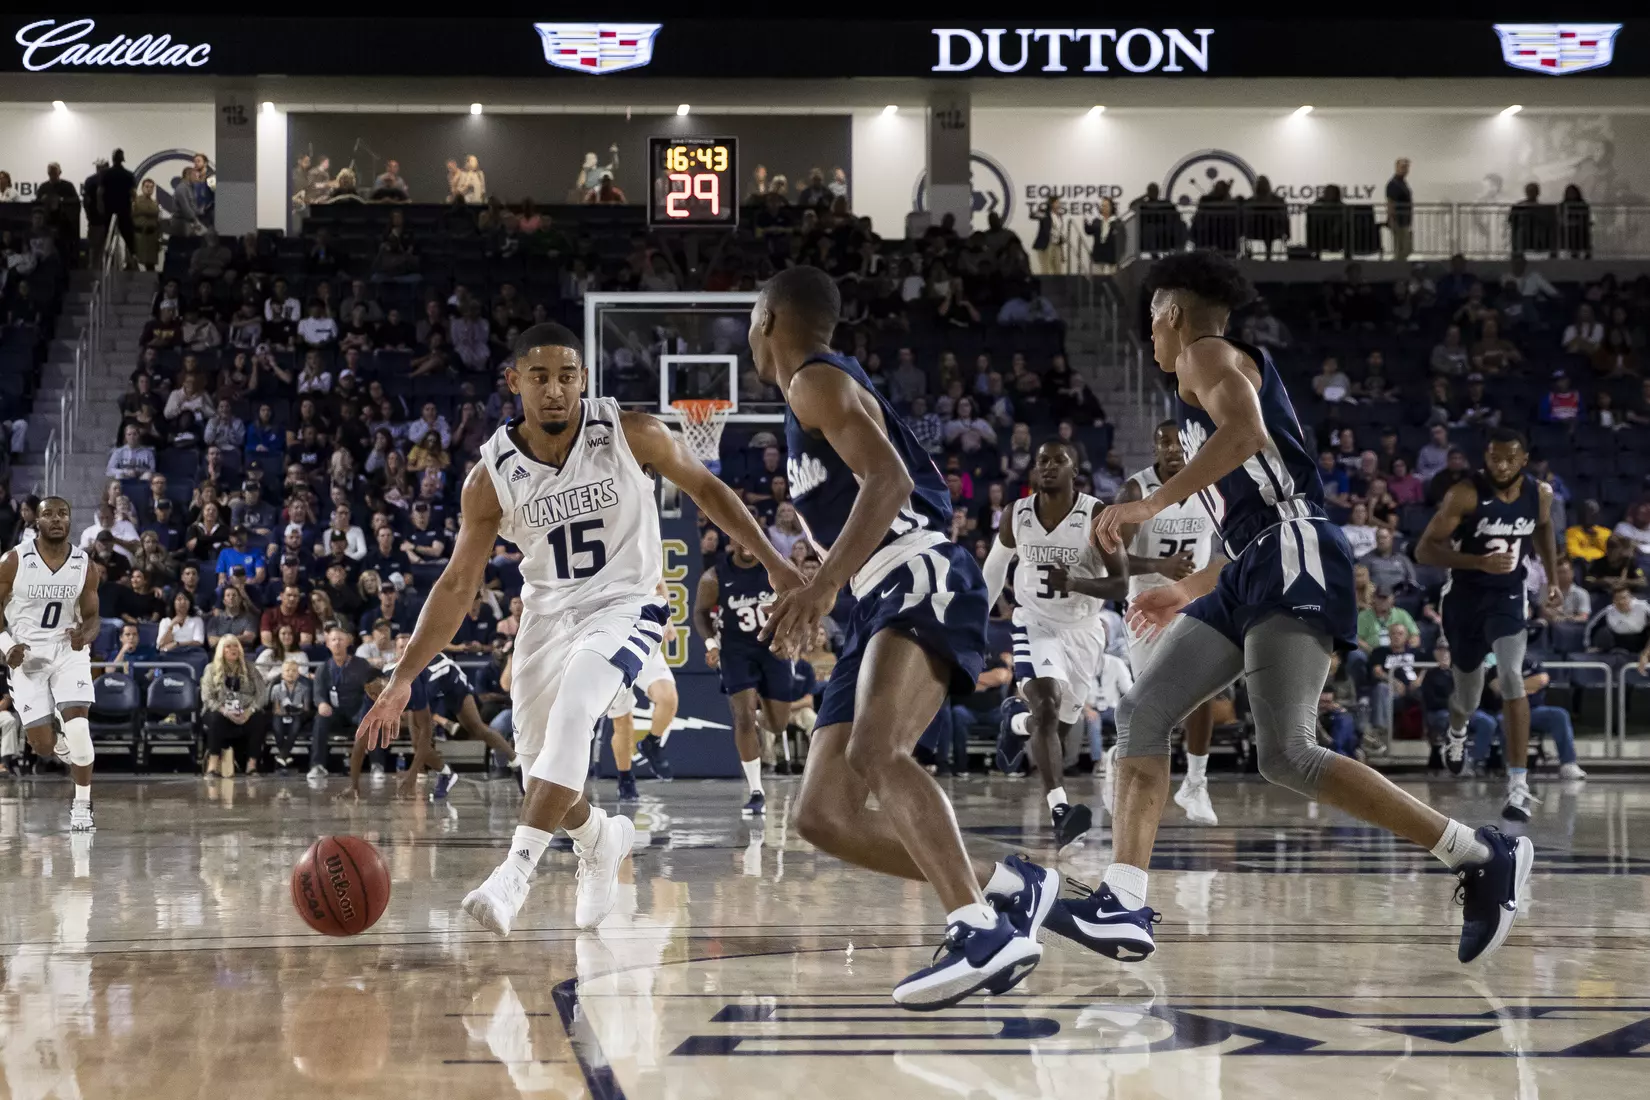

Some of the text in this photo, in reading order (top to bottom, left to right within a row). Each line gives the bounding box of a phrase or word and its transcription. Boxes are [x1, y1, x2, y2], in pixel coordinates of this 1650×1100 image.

[15, 18, 212, 71] Cadillac
[931, 28, 1215, 72] DUTTON
[666, 146, 728, 171] 16:43
[666, 173, 719, 217] 29
[1025, 185, 1123, 198] EQUIPPED
[587, 436, 610, 449] WAC
[522, 478, 619, 528] LANCERS
[1152, 517, 1206, 534] LANCERS
[547, 518, 607, 579] 15
[1023, 544, 1080, 565] LANCERS
[28, 585, 77, 599] LANCERS
[41, 602, 62, 628] 0
[324, 852, 356, 921] Wilson
